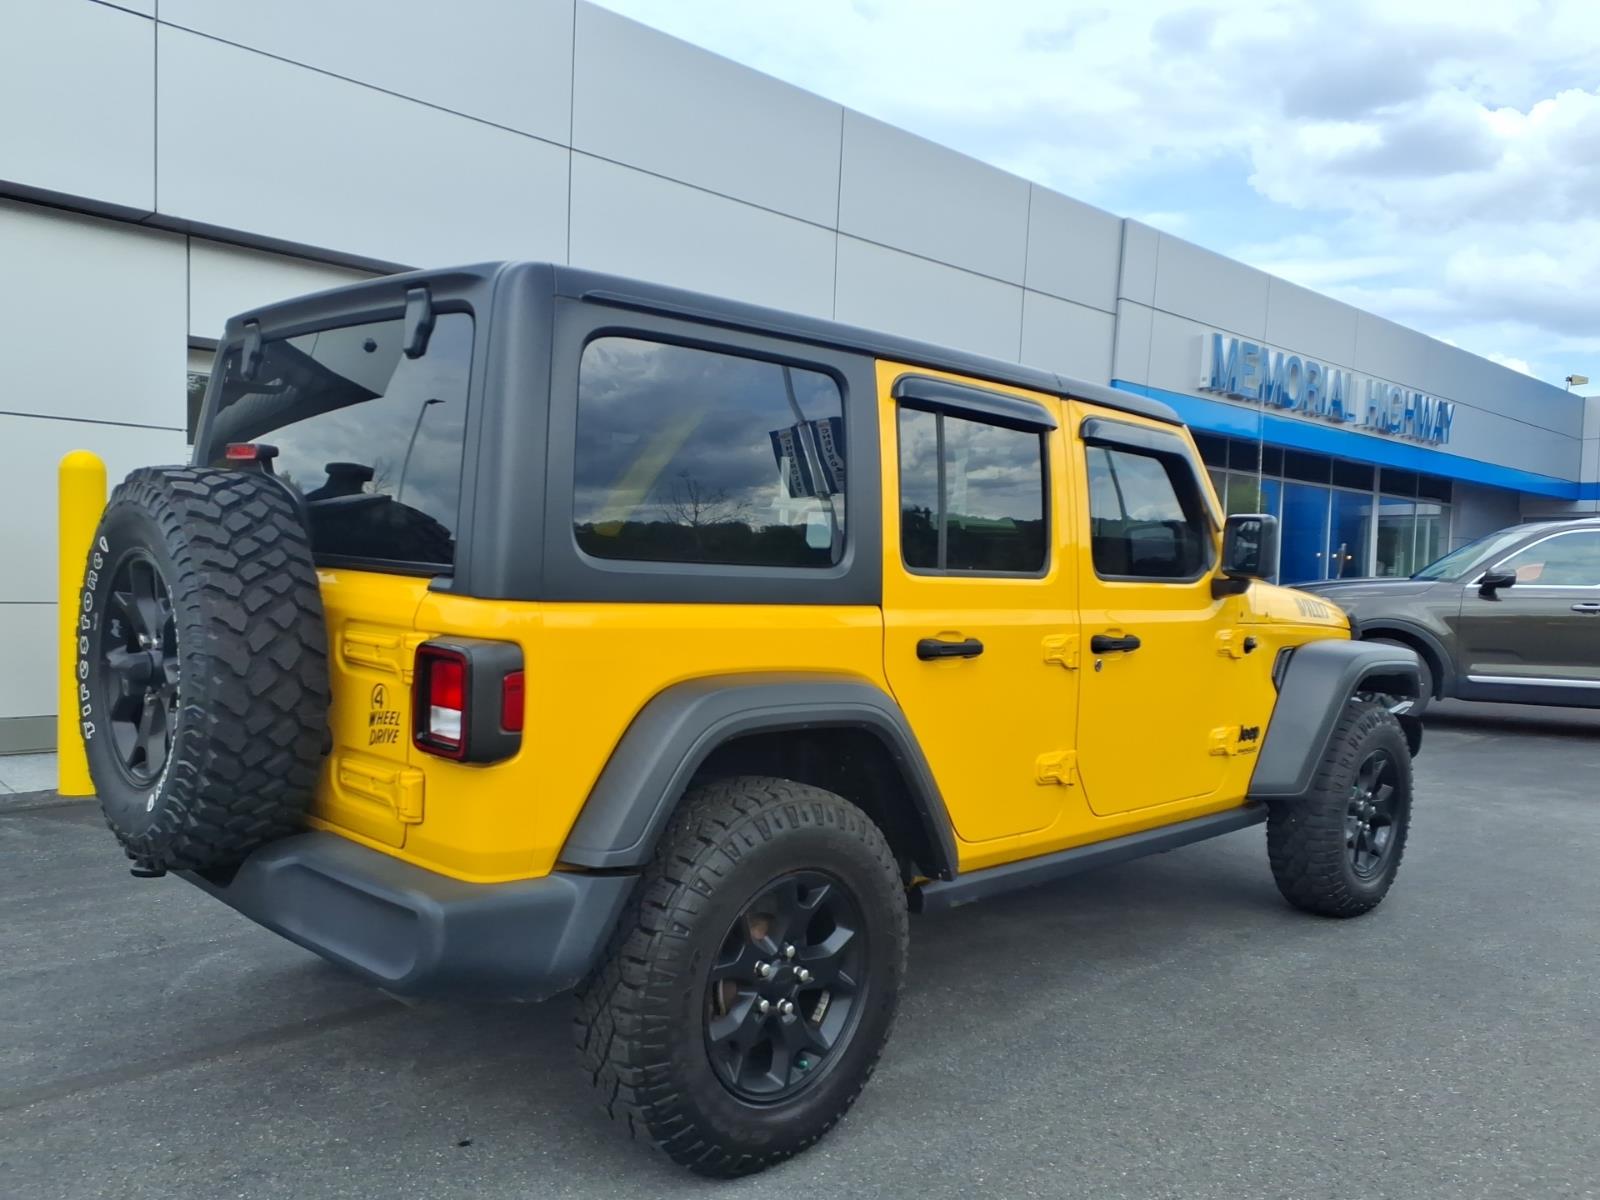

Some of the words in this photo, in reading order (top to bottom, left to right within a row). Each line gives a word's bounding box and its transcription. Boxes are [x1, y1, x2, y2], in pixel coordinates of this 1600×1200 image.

[1208, 333, 1355, 420] MEMORIAL
[1361, 378, 1456, 445] HIGHWAY
[369, 711, 401, 727] WHEEL
[368, 728, 400, 746] DRIVE
[1238, 725, 1259, 743] Jeep
